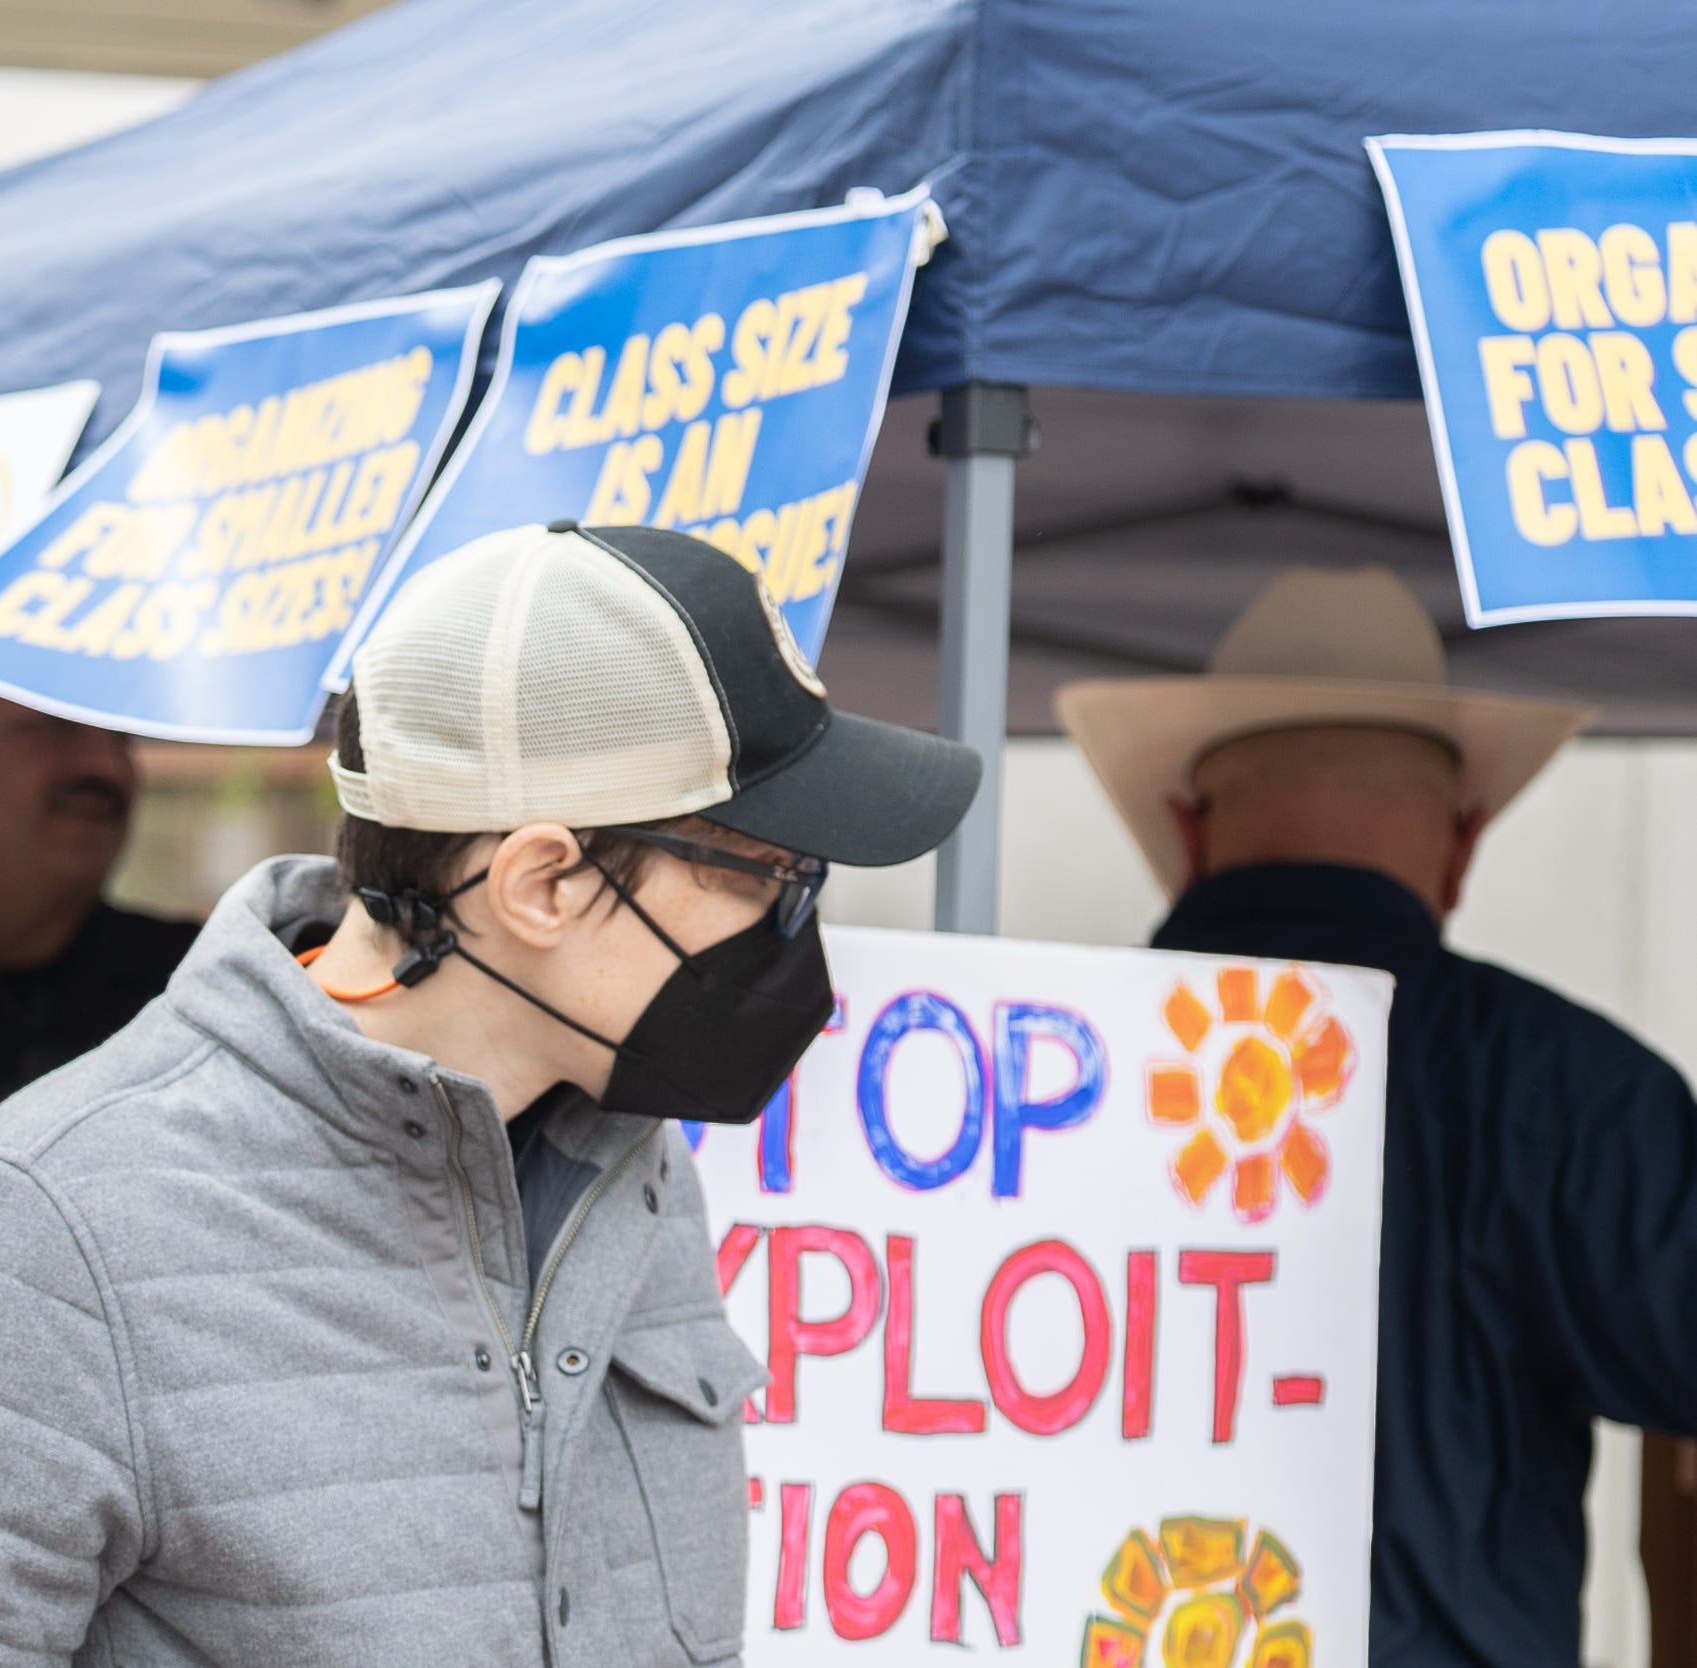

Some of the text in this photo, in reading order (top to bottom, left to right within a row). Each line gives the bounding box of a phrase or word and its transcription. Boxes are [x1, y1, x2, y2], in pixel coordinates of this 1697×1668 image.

[523, 270, 869, 457] CLASS SIZE
[1478, 331, 1667, 439] FOR
[36, 501, 199, 581] FOR
[178, 439, 422, 580] SMALLER
[582, 404, 764, 531] IS AN
[1505, 433, 1697, 547] CLA
[748, 1477, 1022, 1646] ION
